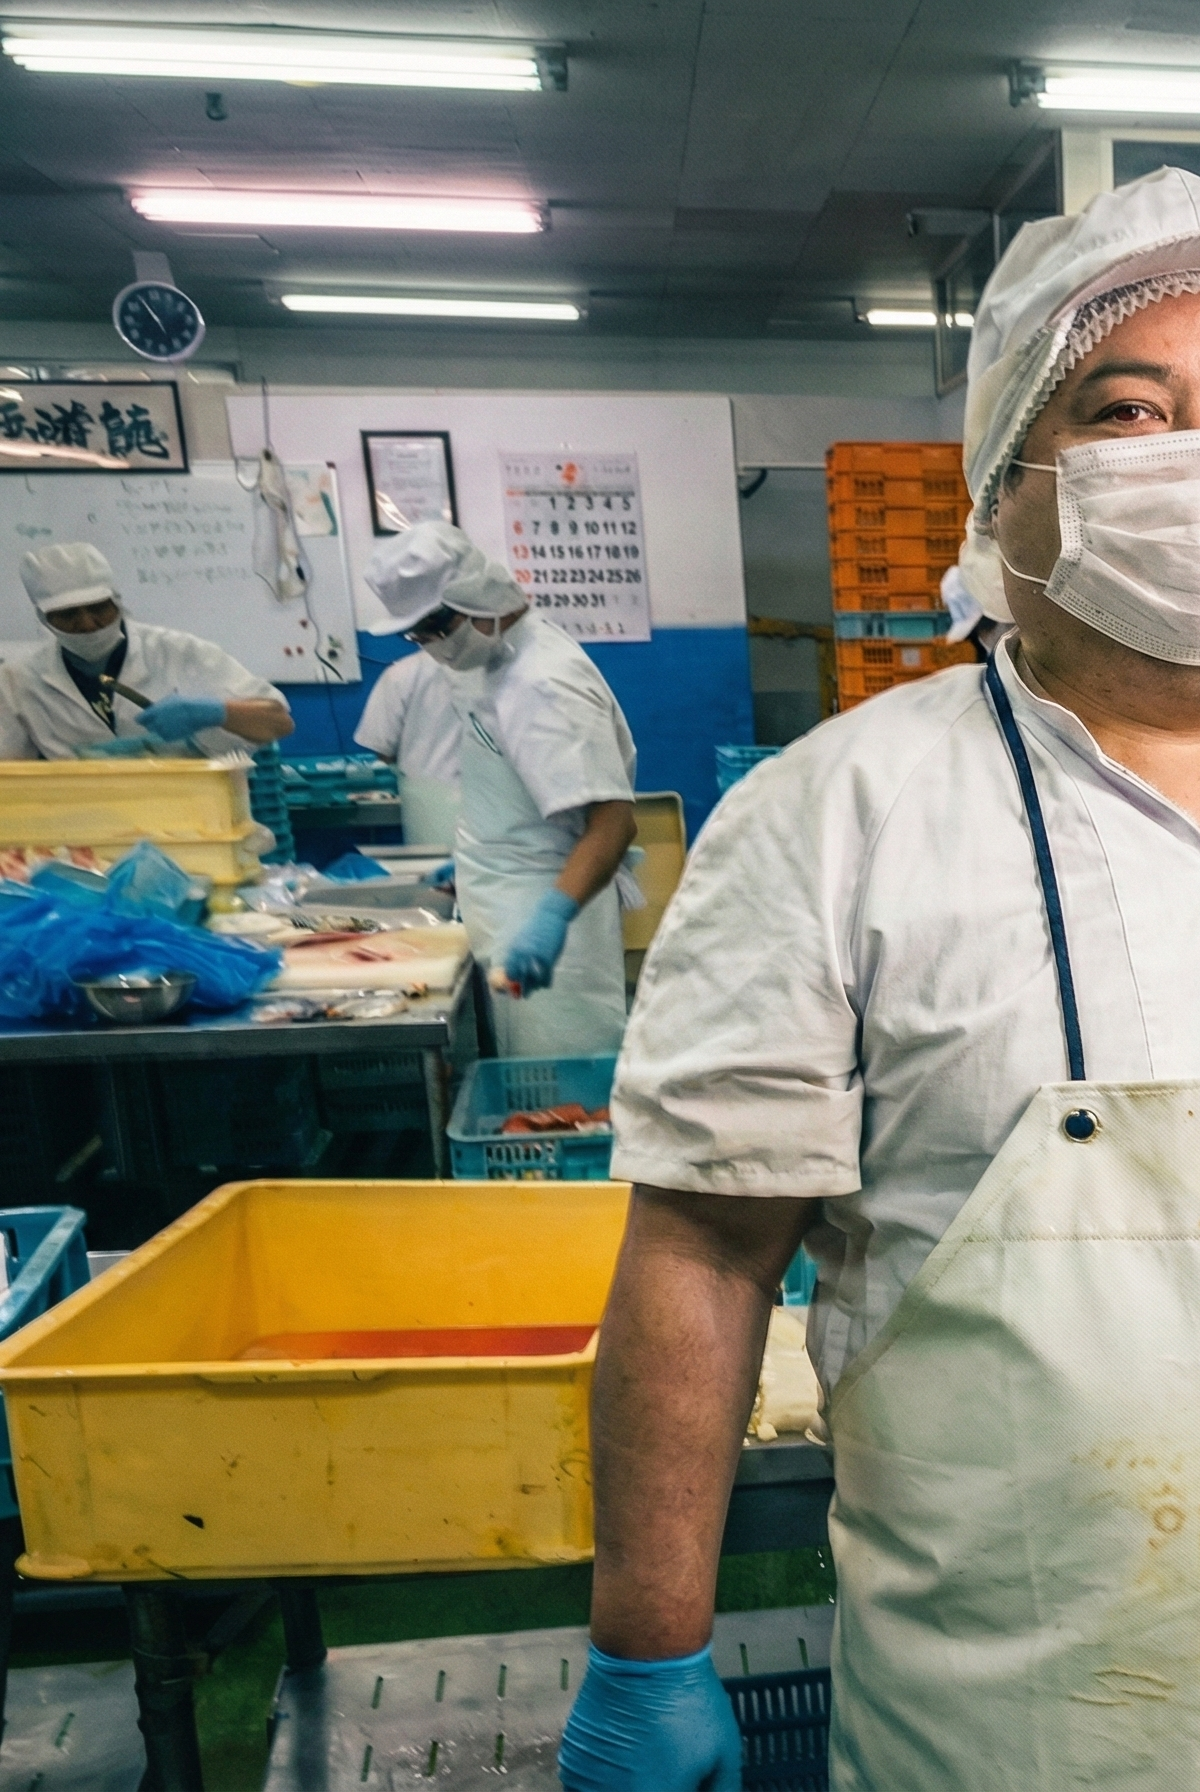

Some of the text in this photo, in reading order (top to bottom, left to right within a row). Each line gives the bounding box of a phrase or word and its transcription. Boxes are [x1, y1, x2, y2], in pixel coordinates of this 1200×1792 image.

[549, 497, 557, 510] 1
[566, 497, 576, 510] 2
[586, 497, 595, 510] 3
[603, 497, 613, 510] 4
[622, 497, 631, 510] 5
[513, 520, 637, 536] 6 7 8 9 10 11 12
[511, 545, 640, 560] 13 14 15 16 17 18 19
[515, 569, 642, 584] 20 21 22 23 24 25 26
[534, 593, 552, 607] 28
[553, 593, 570, 607] 29
[571, 593, 589, 607] 30
[589, 593, 606, 607] 31
